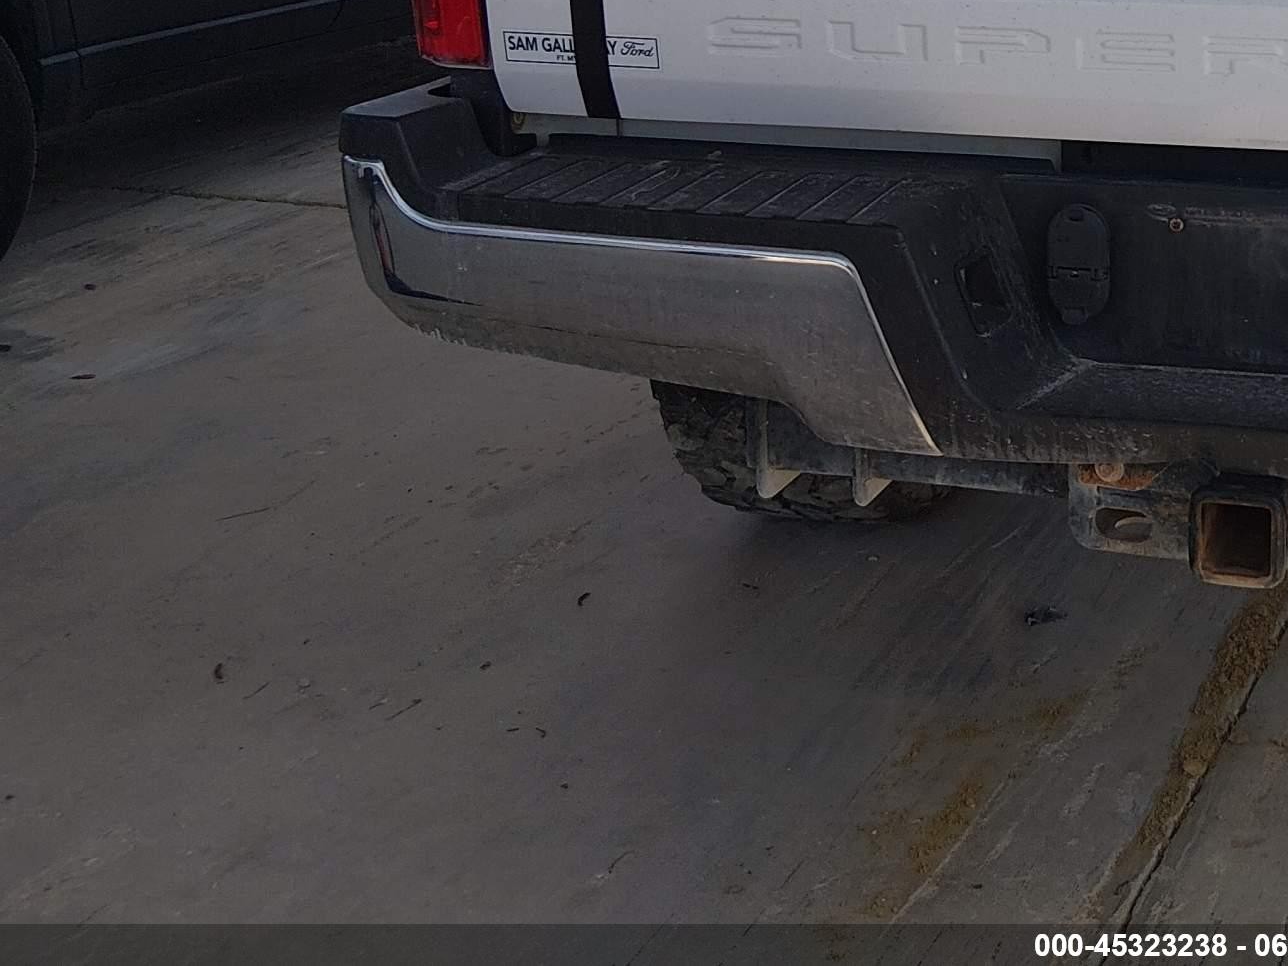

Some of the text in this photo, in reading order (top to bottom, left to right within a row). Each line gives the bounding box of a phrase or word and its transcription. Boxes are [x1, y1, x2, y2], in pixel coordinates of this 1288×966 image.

[508, 36, 655, 57] SAM GALLY Ford
